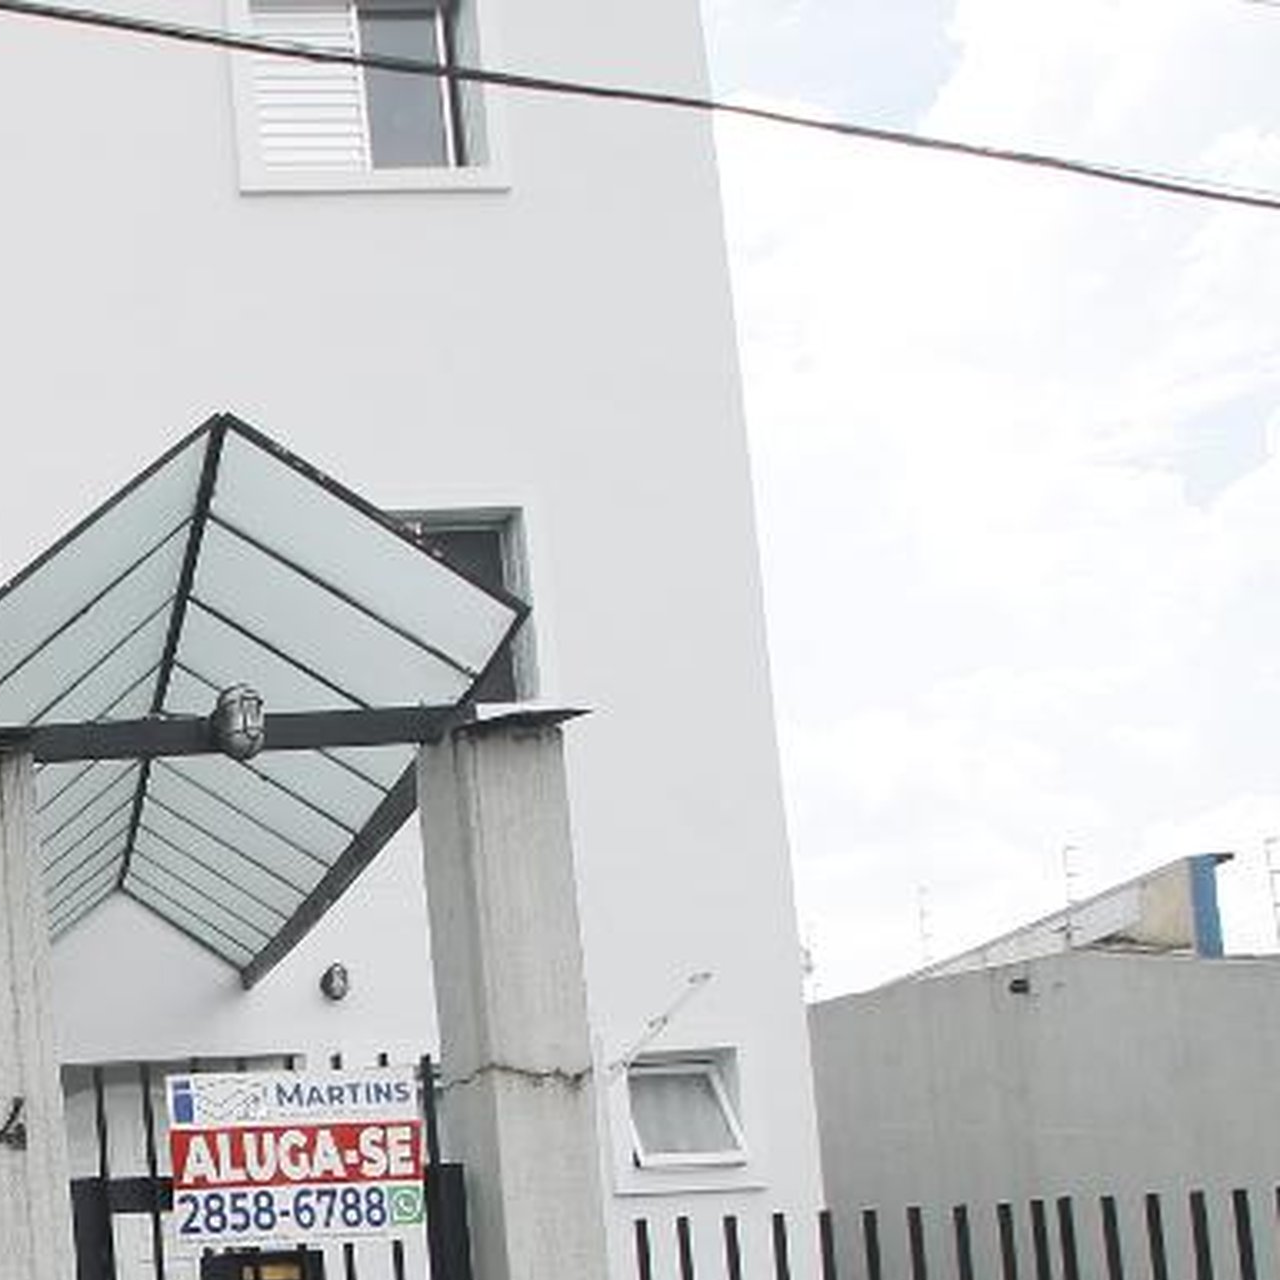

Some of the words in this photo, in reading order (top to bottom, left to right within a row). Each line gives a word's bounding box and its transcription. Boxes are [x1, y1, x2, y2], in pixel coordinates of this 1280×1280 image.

[275, 1081, 412, 1108] MARTINS
[181, 1125, 416, 1185] ALUGA-SE
[178, 1187, 388, 1234] 2858-6788
